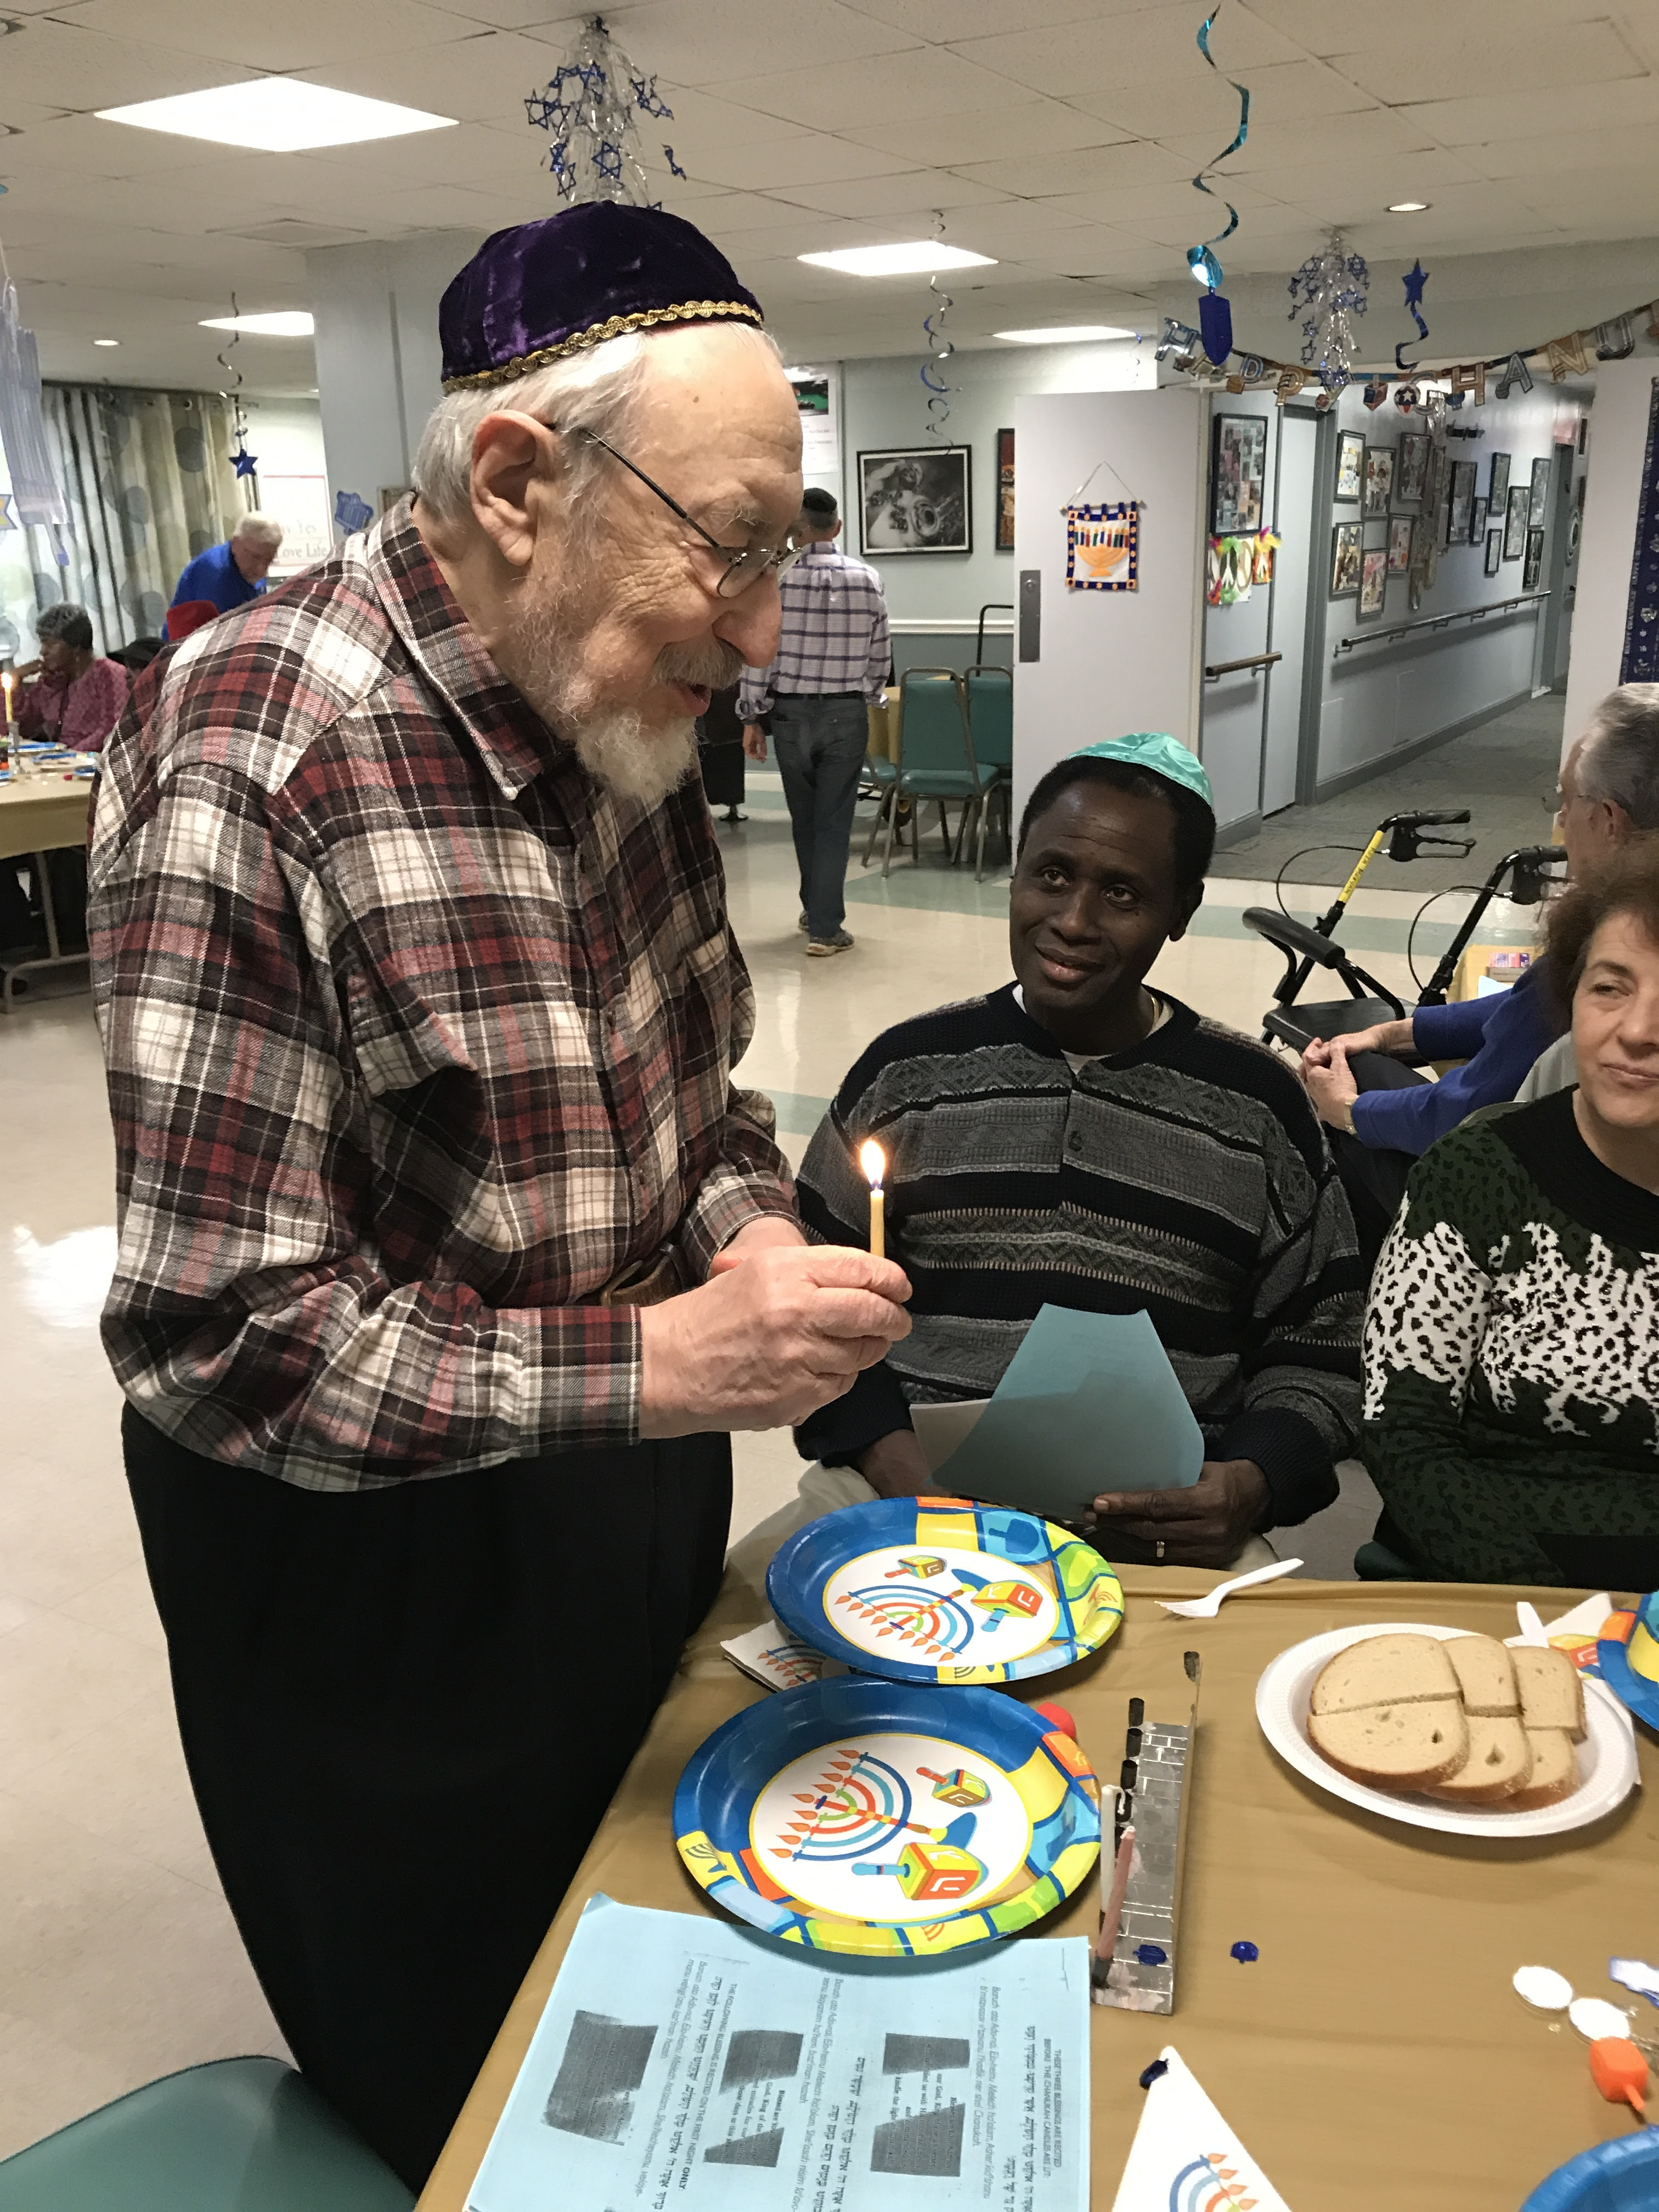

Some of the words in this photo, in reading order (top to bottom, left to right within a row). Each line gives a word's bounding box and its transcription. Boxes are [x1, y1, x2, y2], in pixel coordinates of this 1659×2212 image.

[683, 1959, 695, 1977] manu
[695, 1961, 708, 1983] Baruch
[730, 1983, 738, 1995] THE
[832, 1979, 844, 1999] Baruch
[992, 1987, 1002, 2008] Baruch
[719, 1996, 736, 2032] FOLLOWING
[711, 2033, 725, 2061] BLESSING
[703, 2069, 716, 2095] RECITED
[814, 2070, 826, 2095] Melech
[698, 2097, 709, 2108] ON
[974, 2094, 983, 2108] shel
[988, 2084, 997, 2109] Melech
[696, 2109, 706, 2122] THE
[691, 2124, 702, 2140] FIRST
[684, 2143, 697, 2165] NIGHT
[986, 2143, 995, 2164] Asher
